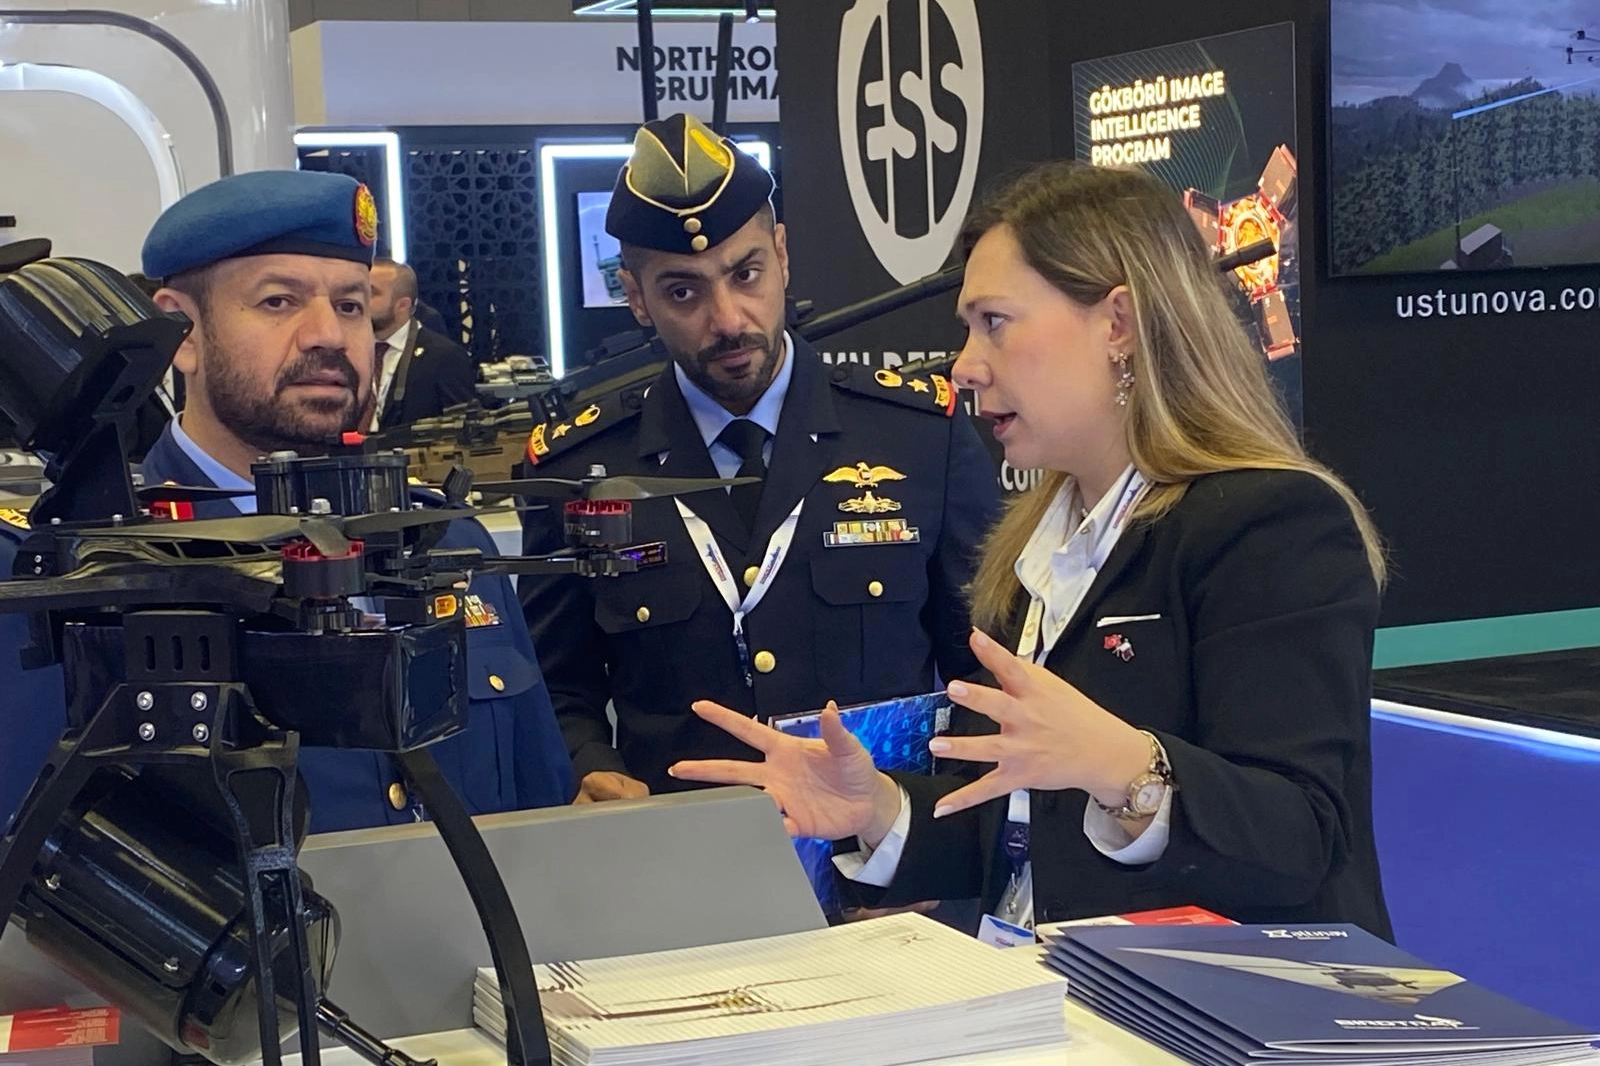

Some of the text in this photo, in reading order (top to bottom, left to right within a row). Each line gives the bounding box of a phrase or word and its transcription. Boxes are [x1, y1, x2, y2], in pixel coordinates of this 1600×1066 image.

[616, 46, 778, 71] NORTHRO
[1089, 71, 1225, 115] GÖKBÖRÜ IMAGE
[1090, 105, 1201, 141] INTELLIGENCE
[1091, 136, 1171, 167] PROGRAM
[1396, 287, 1600, 318] ustunova.co
